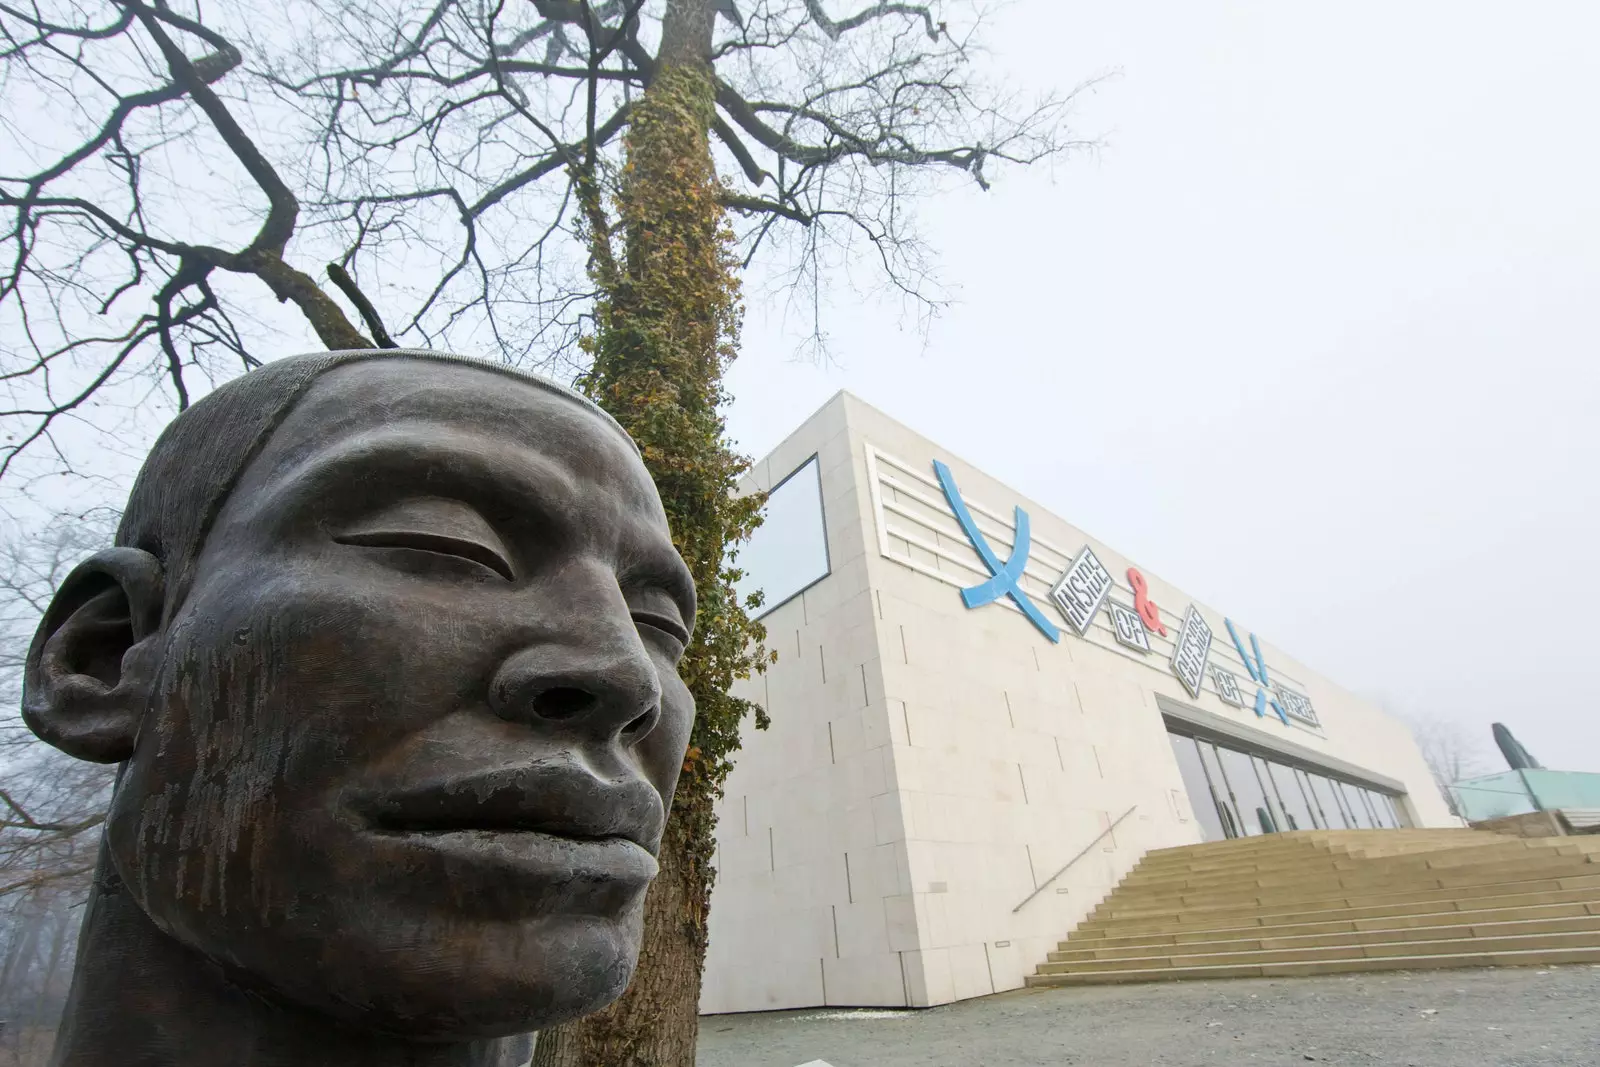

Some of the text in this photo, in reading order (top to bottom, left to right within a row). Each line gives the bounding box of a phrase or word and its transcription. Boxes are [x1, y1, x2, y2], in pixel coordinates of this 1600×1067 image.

[1057, 551, 1109, 627] INSIDE
[1126, 567, 1167, 637] &
[1115, 608, 1142, 644] OF
[1177, 610, 1209, 688] OUTSIDE
[1217, 671, 1237, 701] OF
